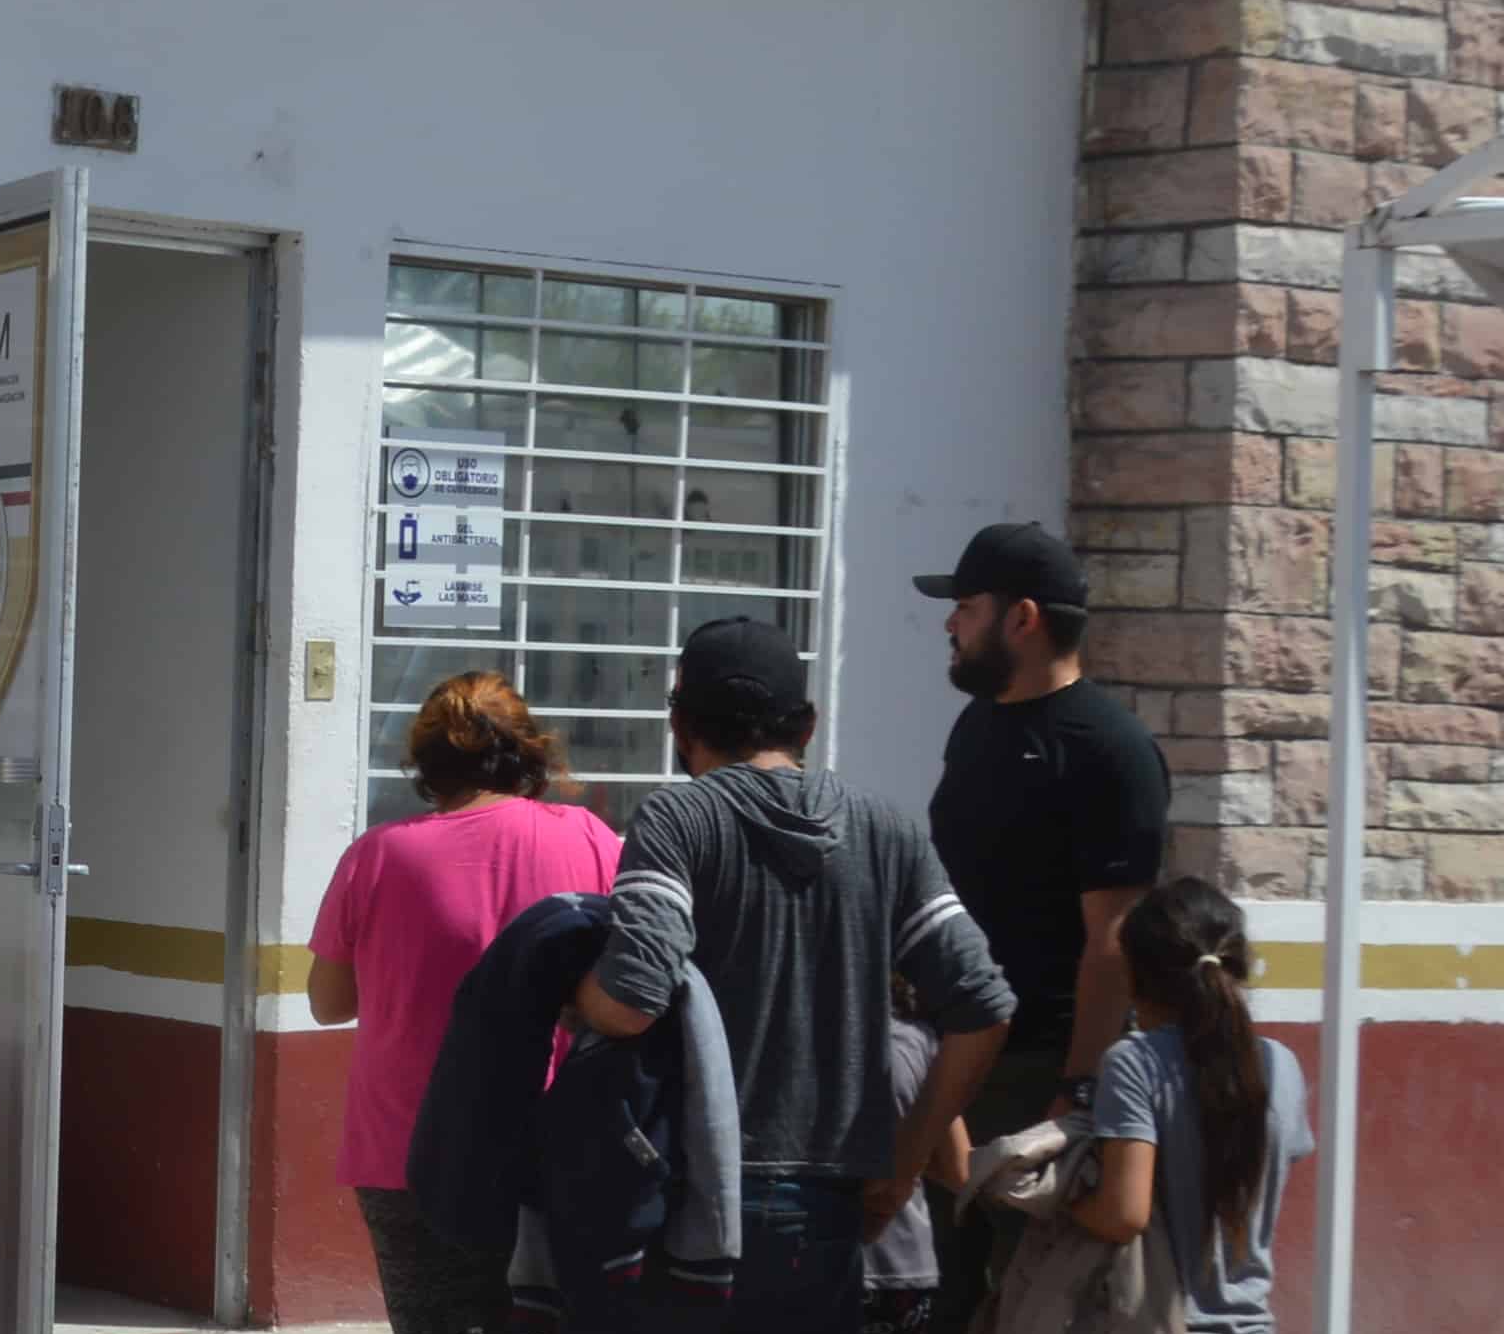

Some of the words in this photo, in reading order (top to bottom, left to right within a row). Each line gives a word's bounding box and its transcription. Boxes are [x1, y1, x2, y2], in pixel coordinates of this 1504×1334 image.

[457, 458, 477, 469] USO
[434, 471, 498, 485] OBLIGATORIO
[457, 523, 473, 534] GEL
[432, 534, 499, 546] ANTIBACTERIAL
[439, 592, 457, 603] LAS
